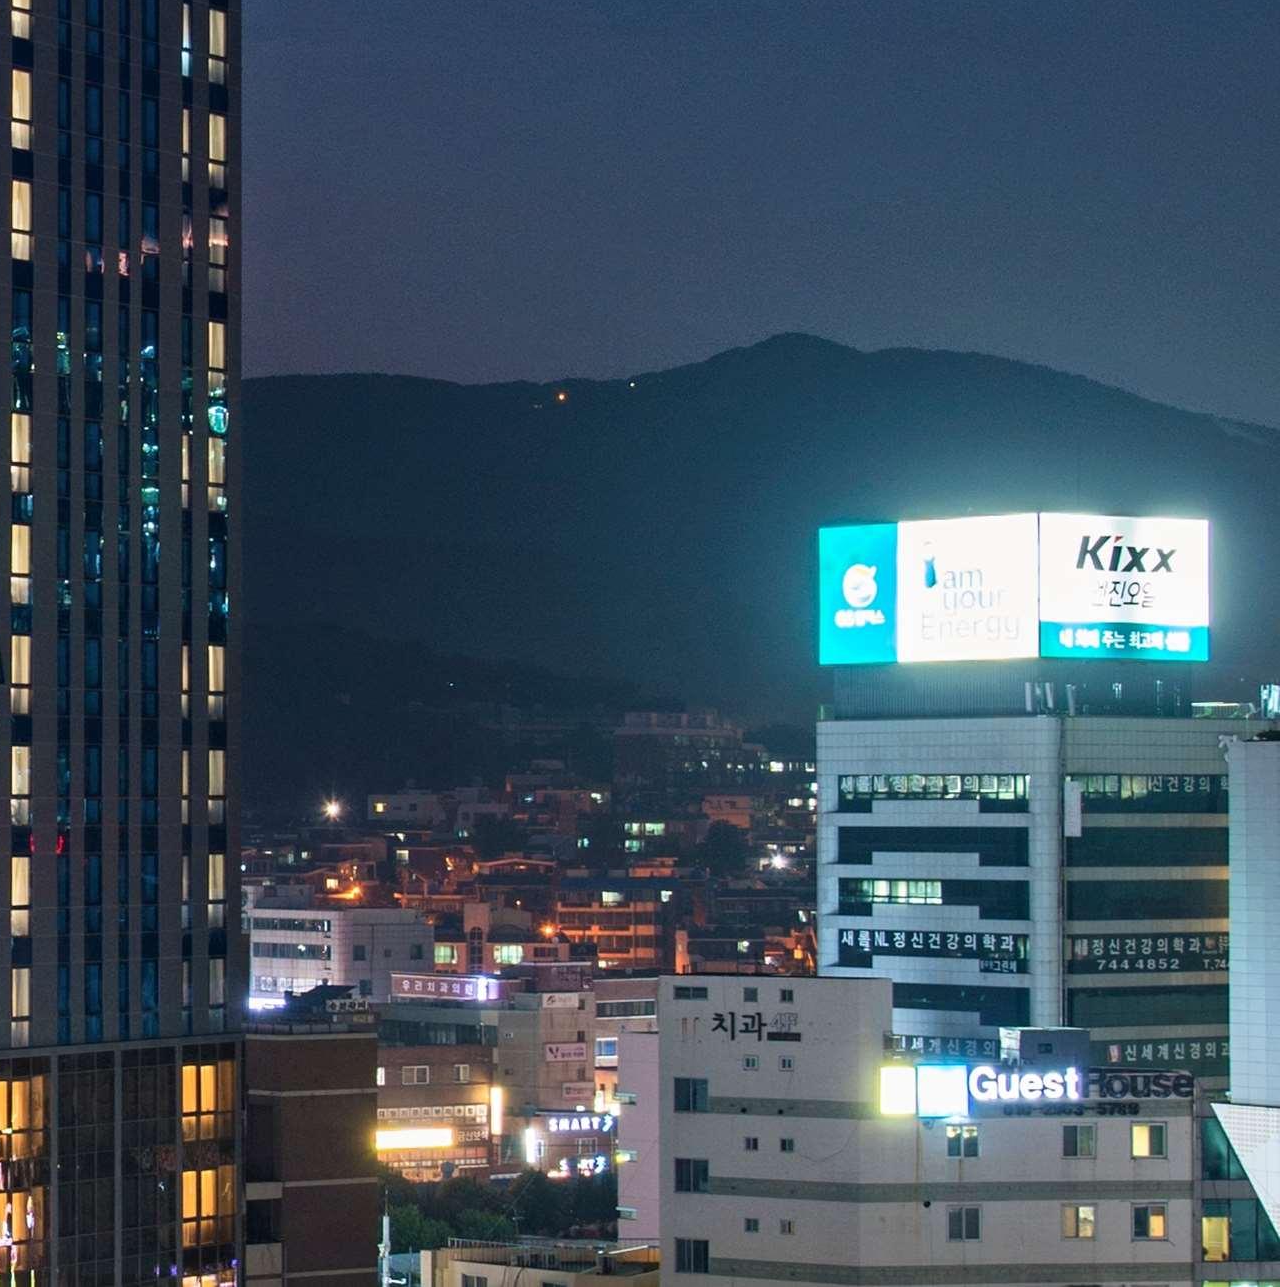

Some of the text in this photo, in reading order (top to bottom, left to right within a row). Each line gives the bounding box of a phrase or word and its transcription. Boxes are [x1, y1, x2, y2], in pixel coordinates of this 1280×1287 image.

[1076, 535, 1177, 574] Kixx
[1097, 959, 1180, 971] 744 4852
[711, 1011, 767, 1041] 치과
[969, 1066, 1081, 1101] Guest
[549, 1116, 601, 1132] SMART
